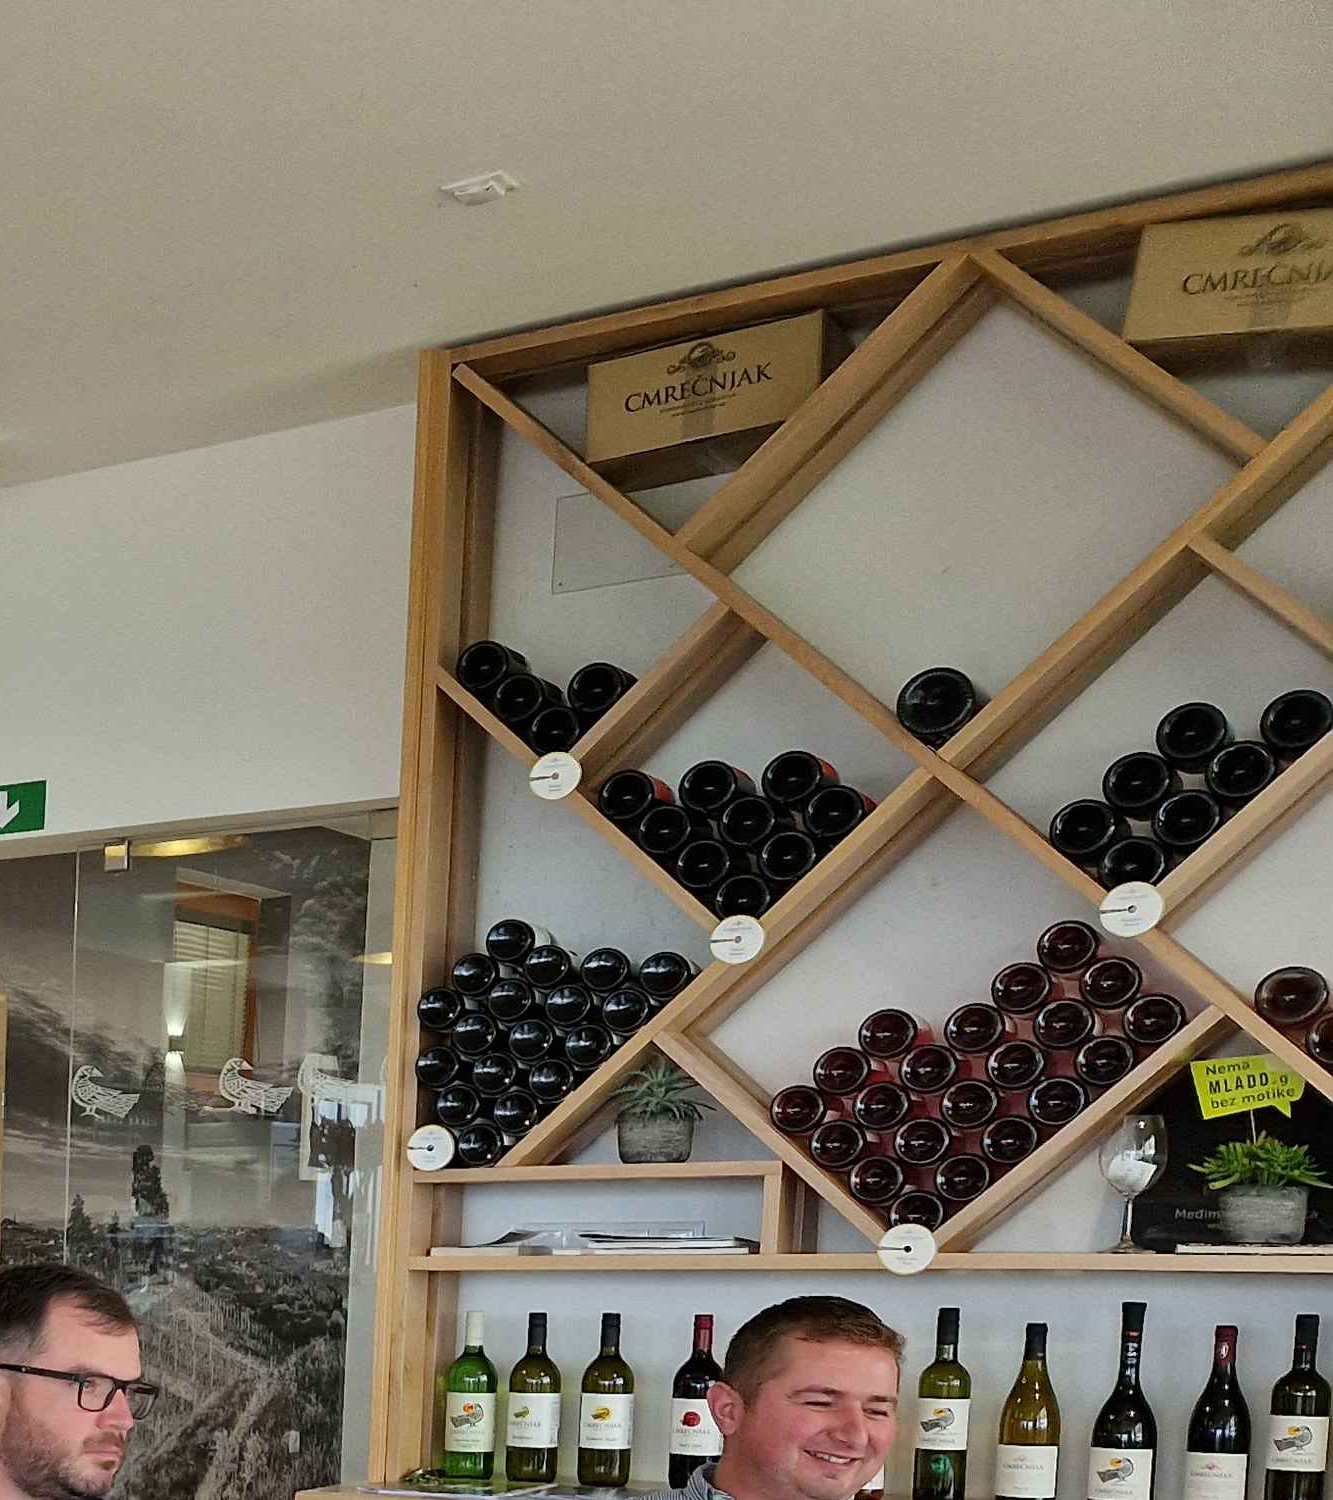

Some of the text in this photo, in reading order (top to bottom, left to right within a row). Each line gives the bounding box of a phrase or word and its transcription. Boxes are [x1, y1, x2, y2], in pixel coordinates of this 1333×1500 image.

[624, 361, 773, 413] CMREČNJAK
[1205, 1061, 1251, 1076] Nema
[1210, 1086, 1296, 1109] bez motike
